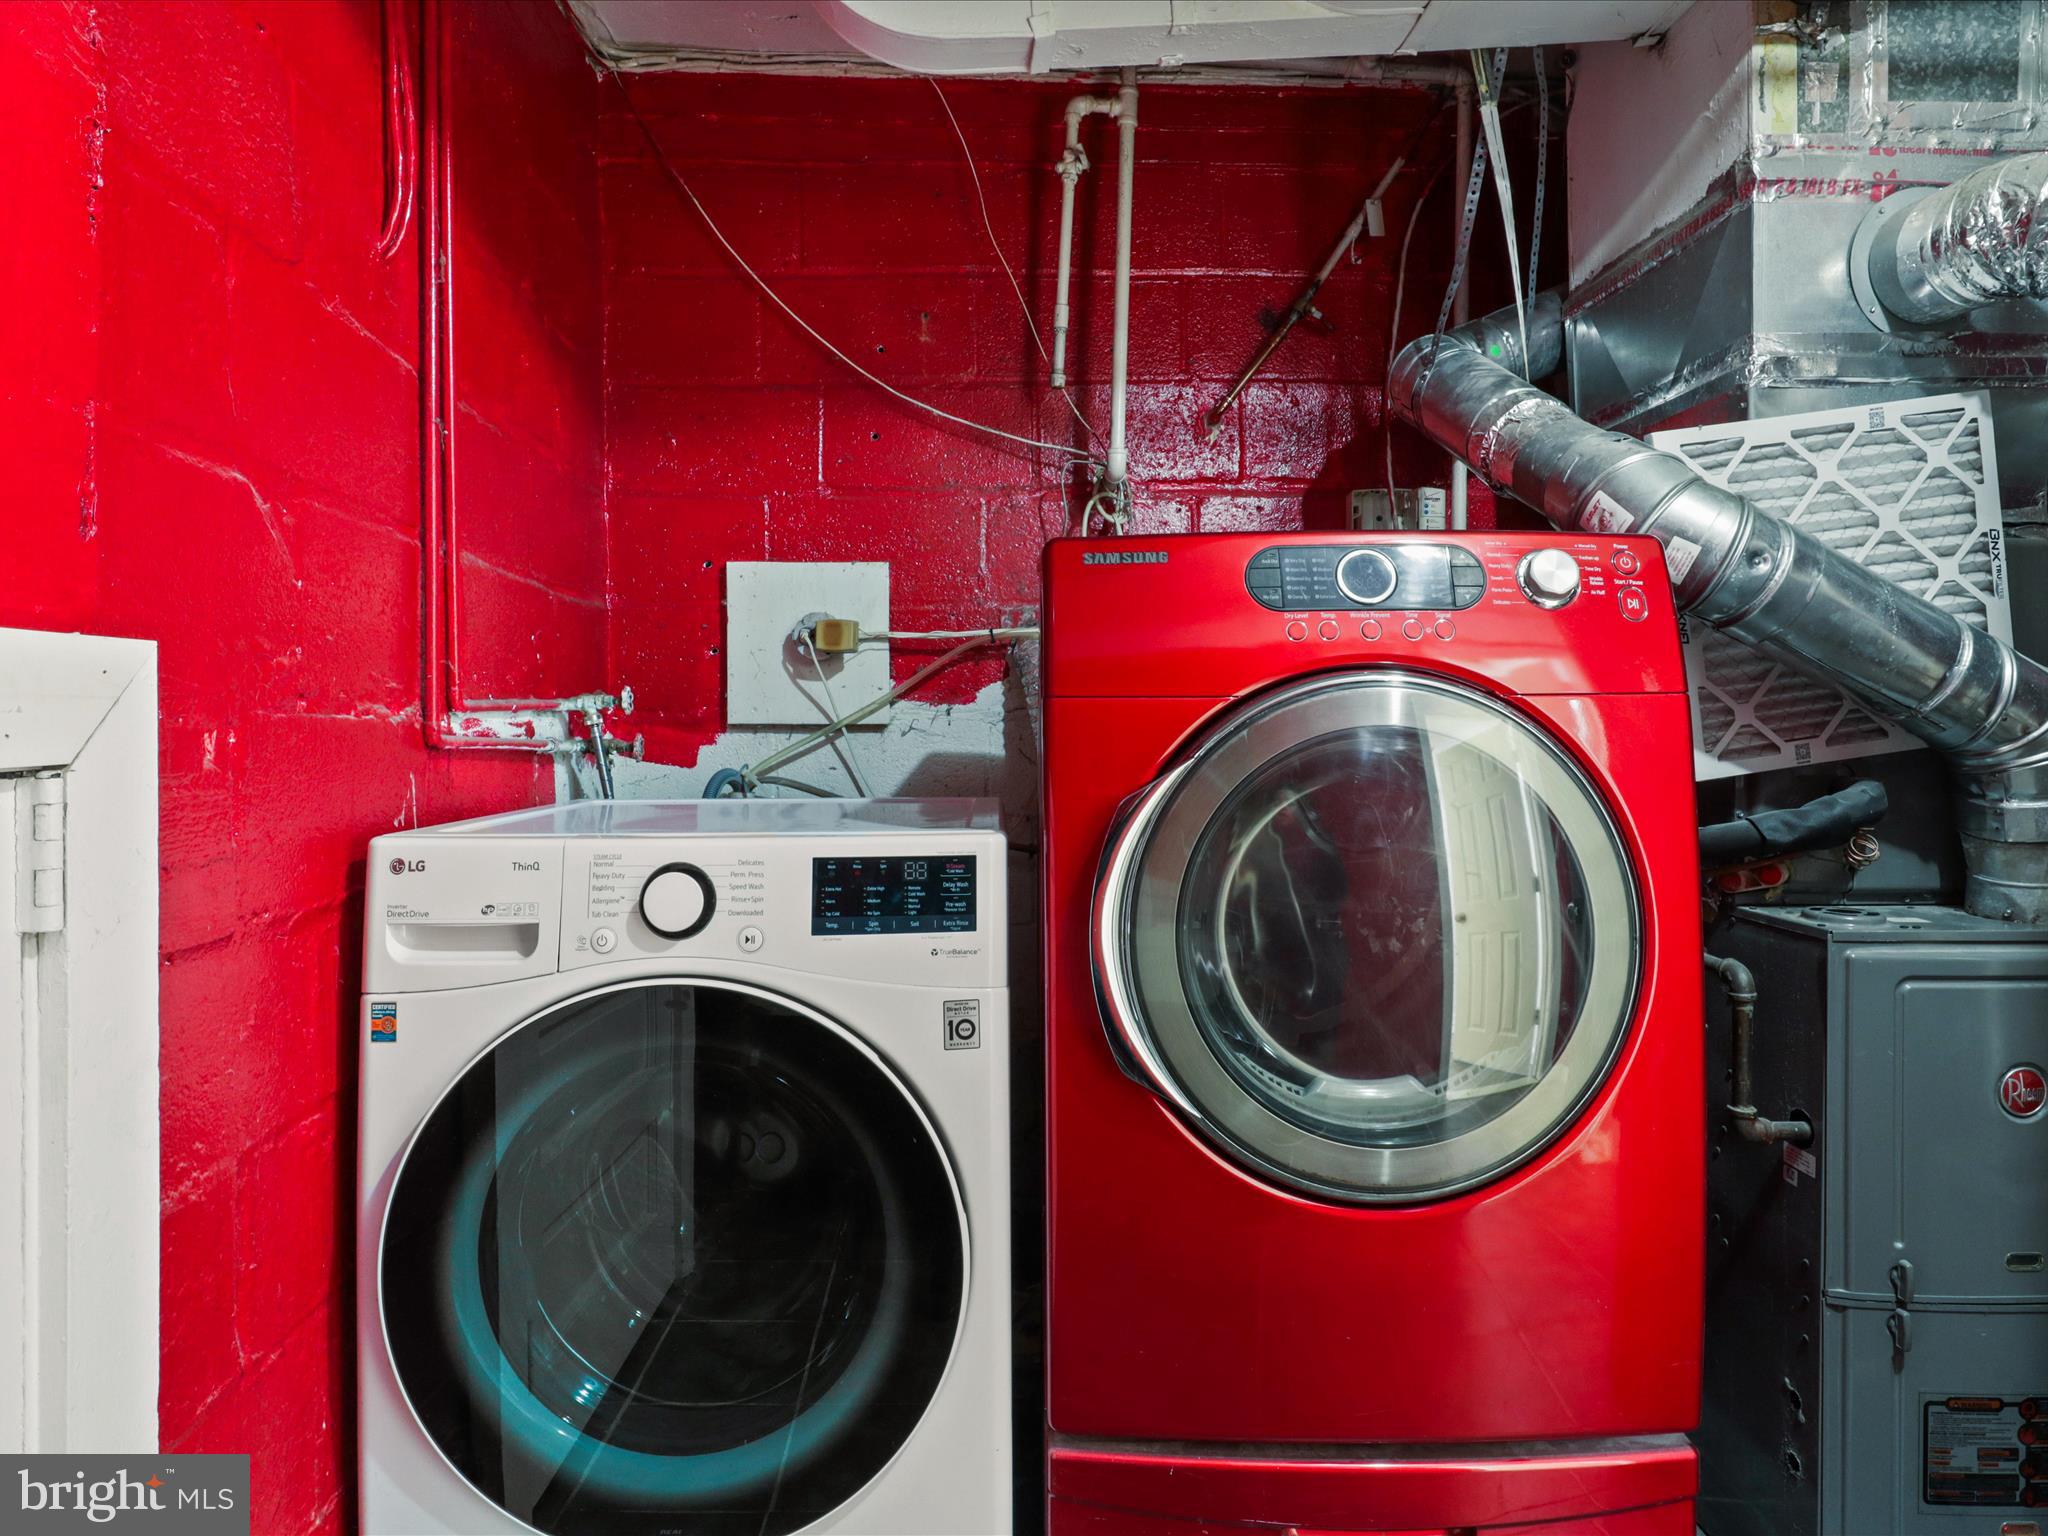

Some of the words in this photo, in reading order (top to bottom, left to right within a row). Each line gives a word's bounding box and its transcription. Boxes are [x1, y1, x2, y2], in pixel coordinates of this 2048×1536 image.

[1989, 528, 2001, 562] BNX
[1083, 551, 1169, 565] SAMSUNG
[1435, 612, 1451, 620] Signal
[408, 860, 426, 872] LG
[511, 861, 540, 872] ThinQ
[592, 872, 610, 881] Heavy
[611, 872, 626, 880] Duty
[591, 885, 615, 893] Bedding
[728, 883, 747, 891] Speed
[947, 1018, 976, 1041] 10
